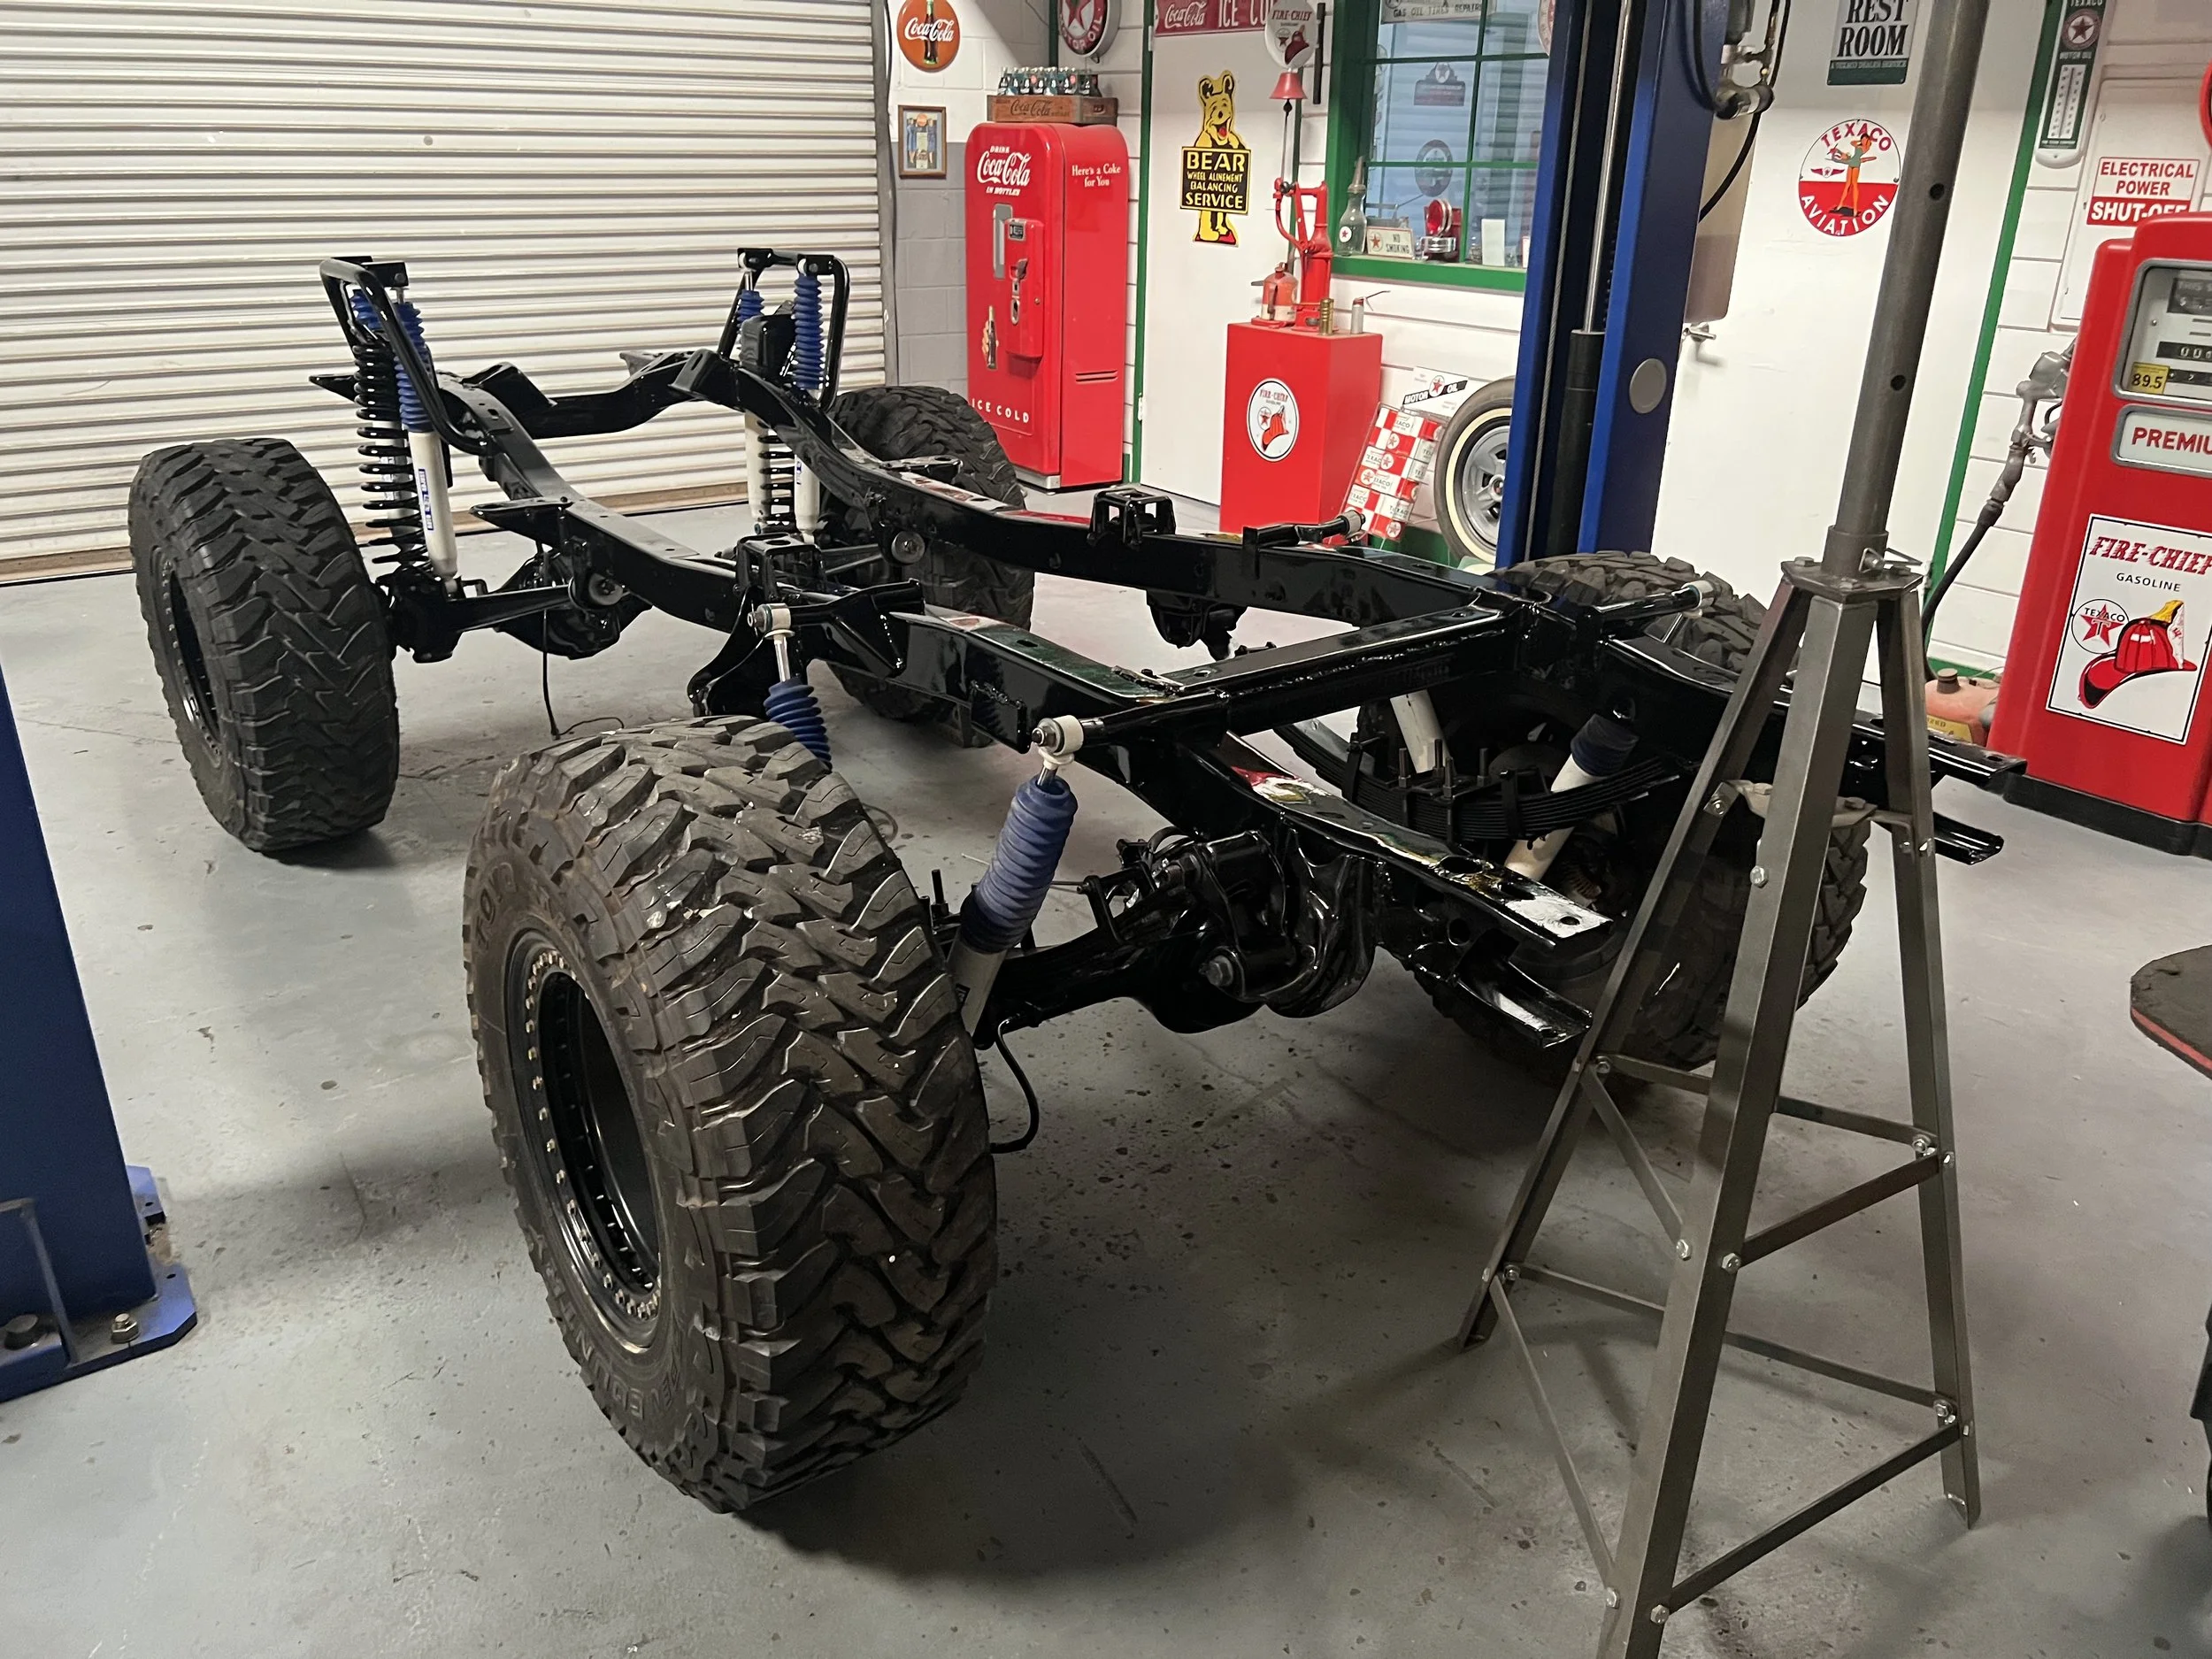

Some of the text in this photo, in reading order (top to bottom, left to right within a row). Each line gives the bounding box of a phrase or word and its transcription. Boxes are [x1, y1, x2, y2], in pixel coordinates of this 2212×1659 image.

[1164, 2, 1207, 29] Coca-Cola
[1218, 0, 1239, 27] ICE
[1846, 0, 1904, 23] REST
[904, 17, 955, 45] Coca-Cola
[1087, 15, 1103, 42] OIL
[1837, 25, 1909, 57] ROOM
[1821, 122, 1892, 151] TEXACO
[977, 150, 1032, 187] Coca-Cola
[1071, 165, 1094, 176] Here's
[1103, 163, 1121, 175] Coke
[1187, 151, 1245, 172] BEAR
[2100, 161, 2194, 178] ELECTRICAL
[1084, 176, 1110, 188] for You
[1187, 171, 1206, 180] WHEEL
[1190, 180, 1238, 194] BALANCING
[2116, 180, 2170, 196] POWER
[1186, 192, 1243, 209] SERVICE
[1801, 194, 1889, 235] AVIATION
[2131, 373, 2163, 389] 89.5
[1404, 390, 1428, 404] MOTOR
[972, 397, 1029, 423] ICE COLD
[2089, 536, 2212, 575] FIRE-CHIEF
[2116, 572, 2181, 592] GASOLINE
[2085, 607, 2125, 622] TEXACO
